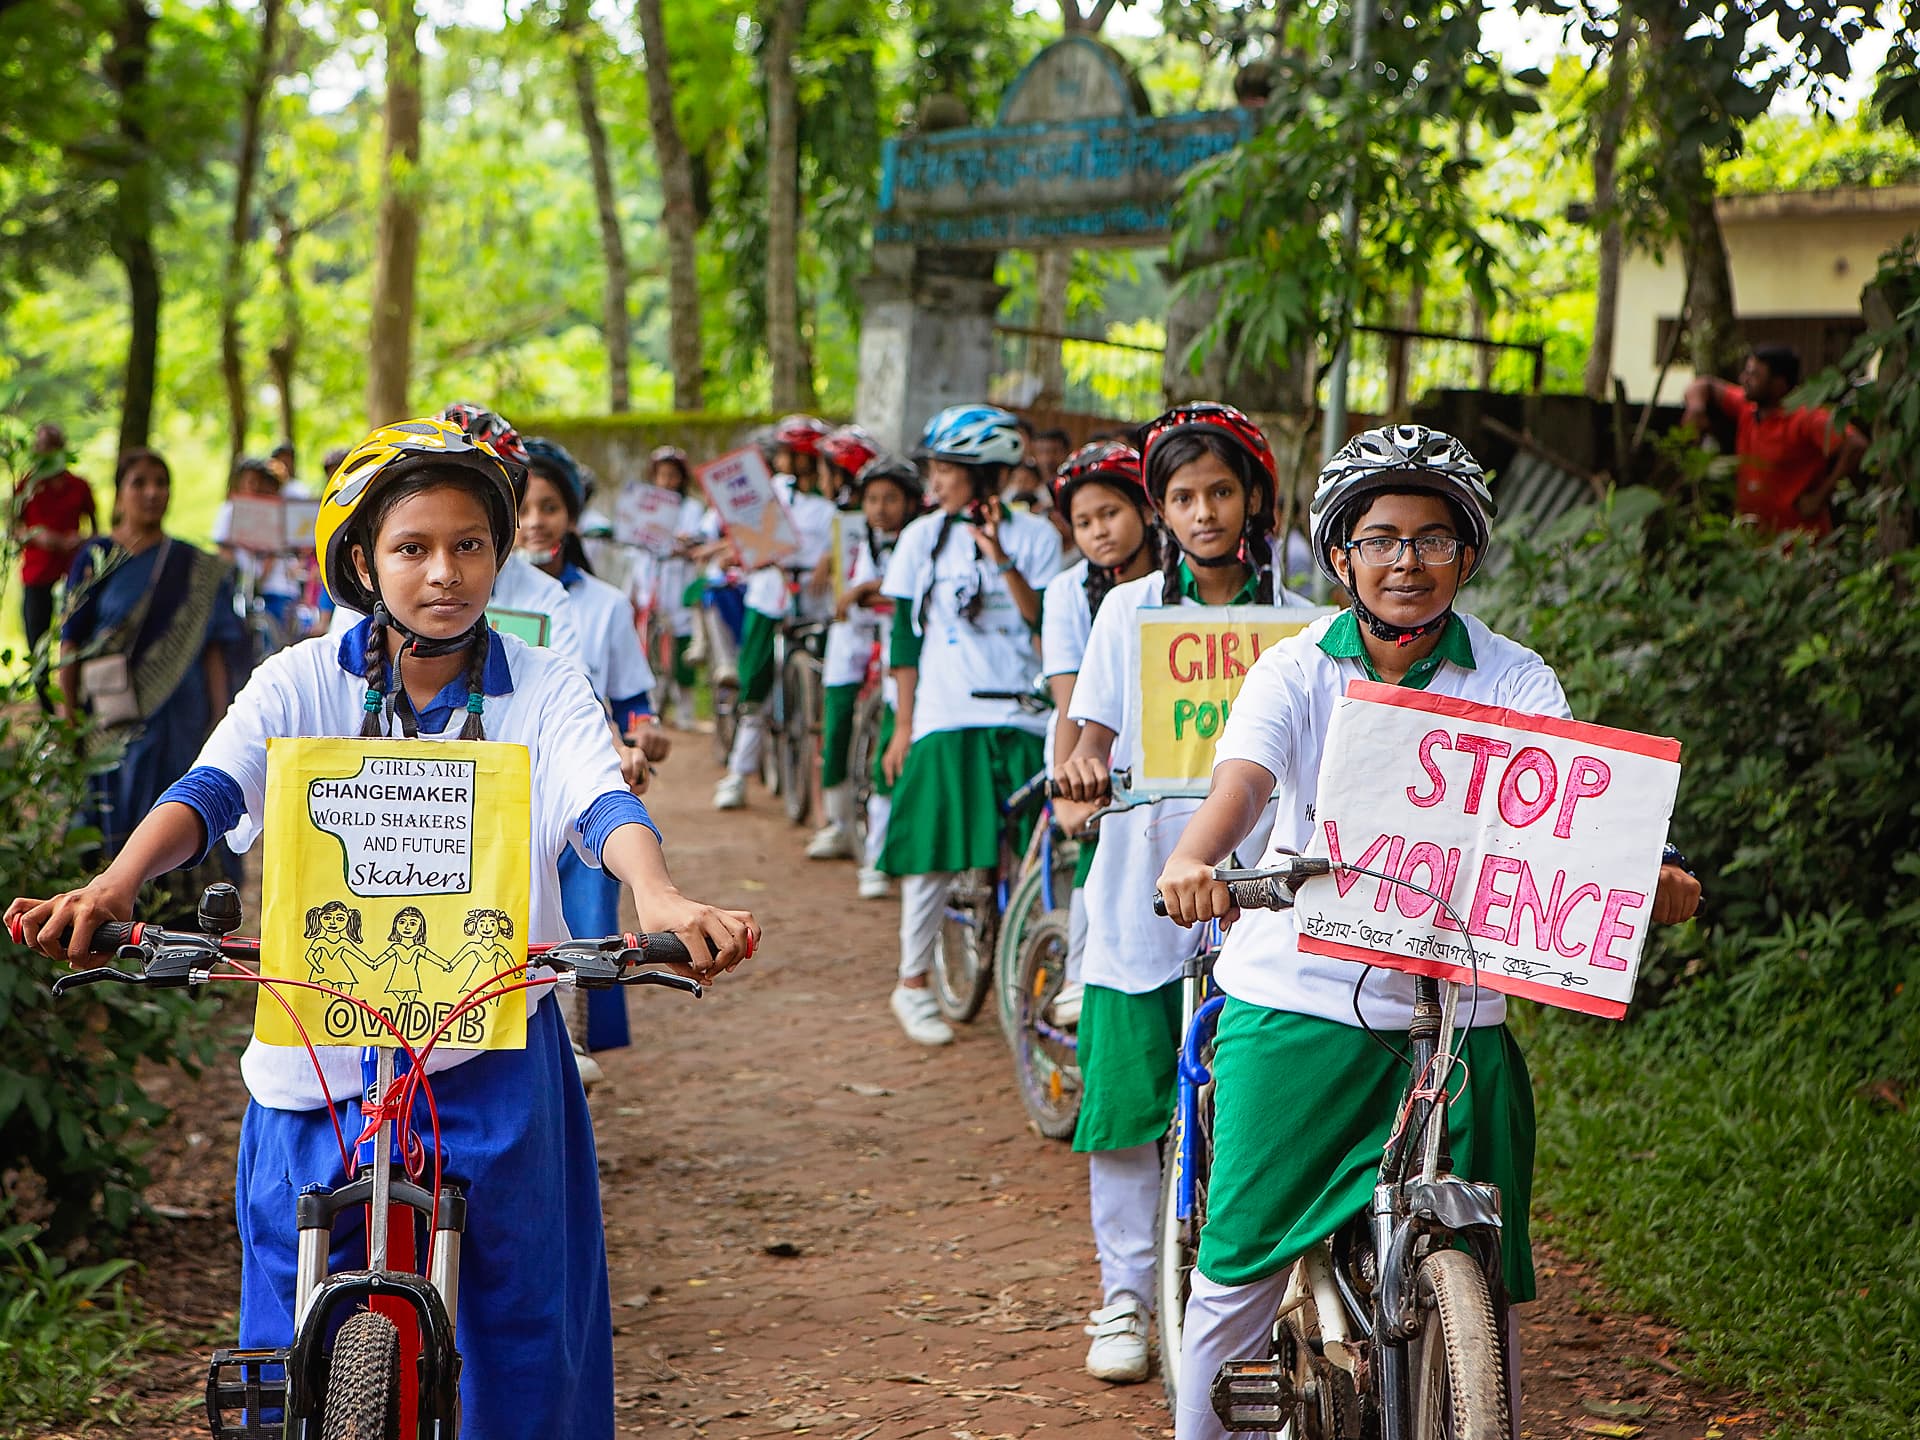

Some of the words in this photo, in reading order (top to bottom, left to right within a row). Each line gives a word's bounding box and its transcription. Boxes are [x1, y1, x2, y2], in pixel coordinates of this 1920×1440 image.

[1173, 698, 1230, 741] PO
[370, 760, 426, 777] GIRLS
[430, 762, 469, 778] ARE
[1406, 728, 1612, 839] STOP
[311, 782, 468, 803] CHANGEMAKER
[314, 808, 376, 826] WORLD
[381, 812, 467, 830] SHAKERS
[363, 836, 397, 852] AND
[402, 837, 466, 854] FUTURE
[351, 861, 466, 890] Skahers
[1323, 820, 1649, 972] VIOLENCE
[324, 998, 487, 1044] OWDEB
